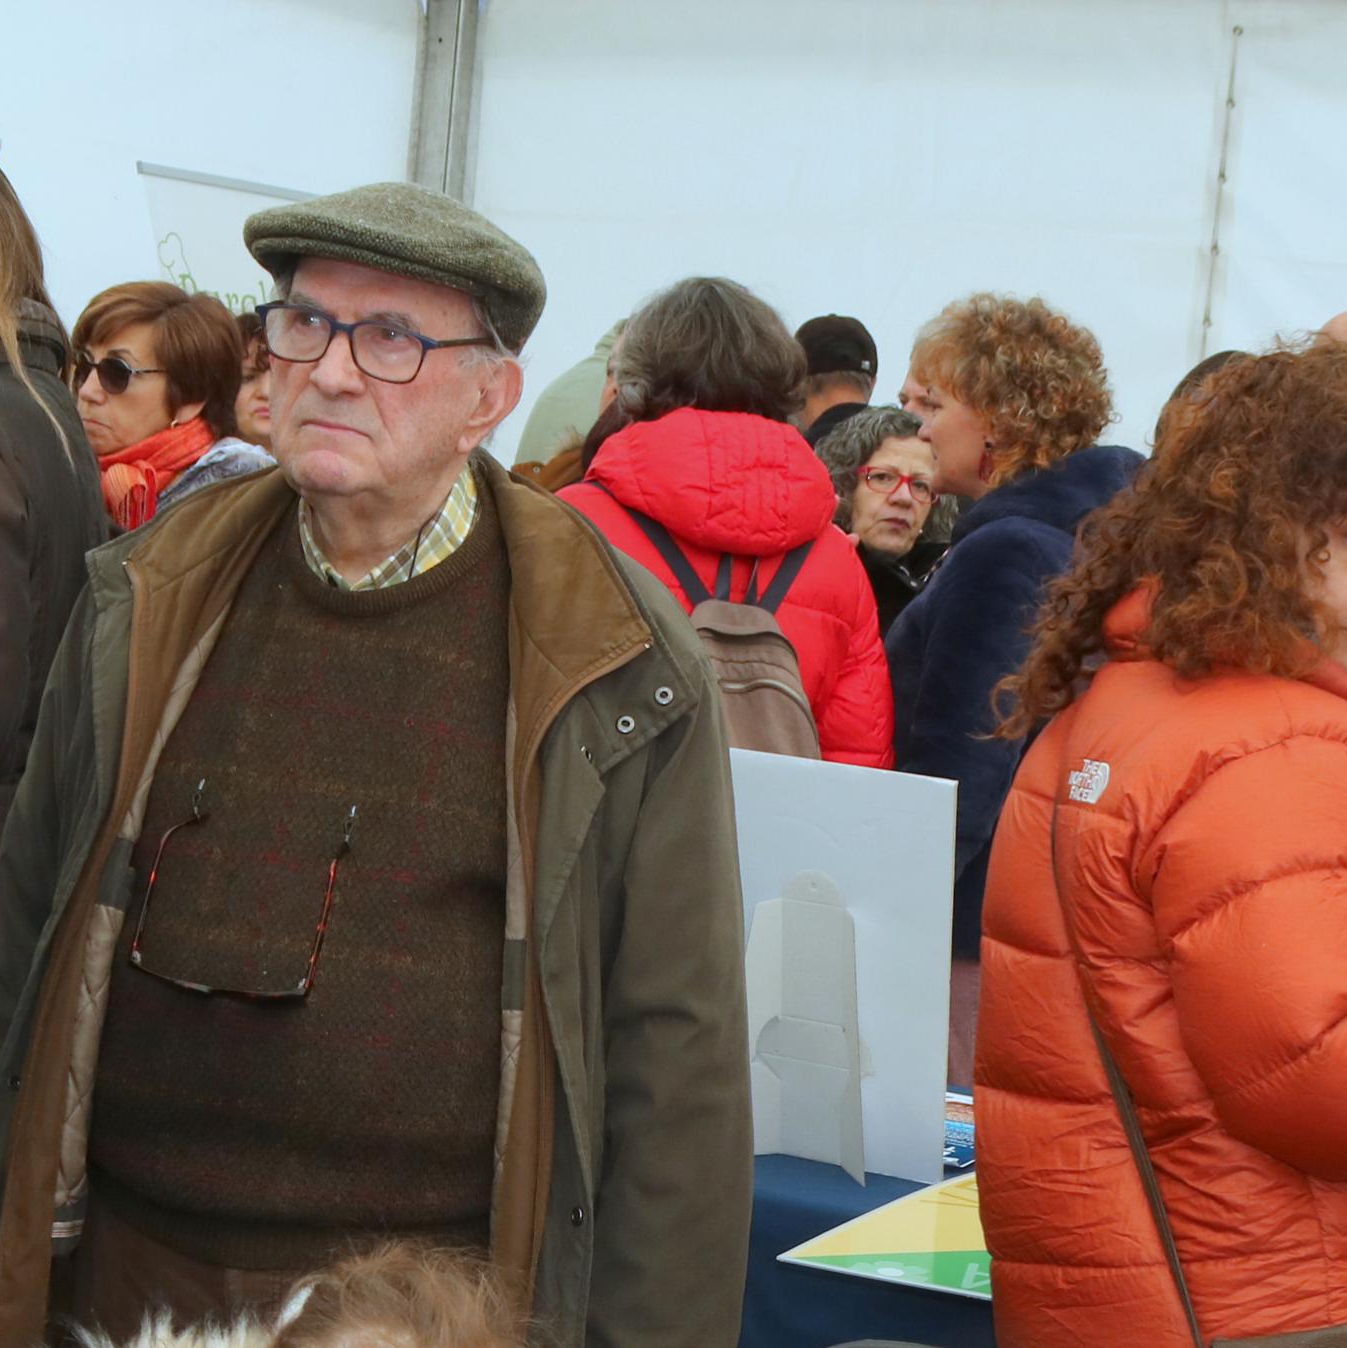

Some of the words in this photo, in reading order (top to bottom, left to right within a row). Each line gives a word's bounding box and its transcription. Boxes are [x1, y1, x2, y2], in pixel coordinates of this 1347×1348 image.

[1083, 759, 1100, 775] THE
[1068, 770, 1093, 790] NORTH
[1069, 785, 1093, 803] FACE
